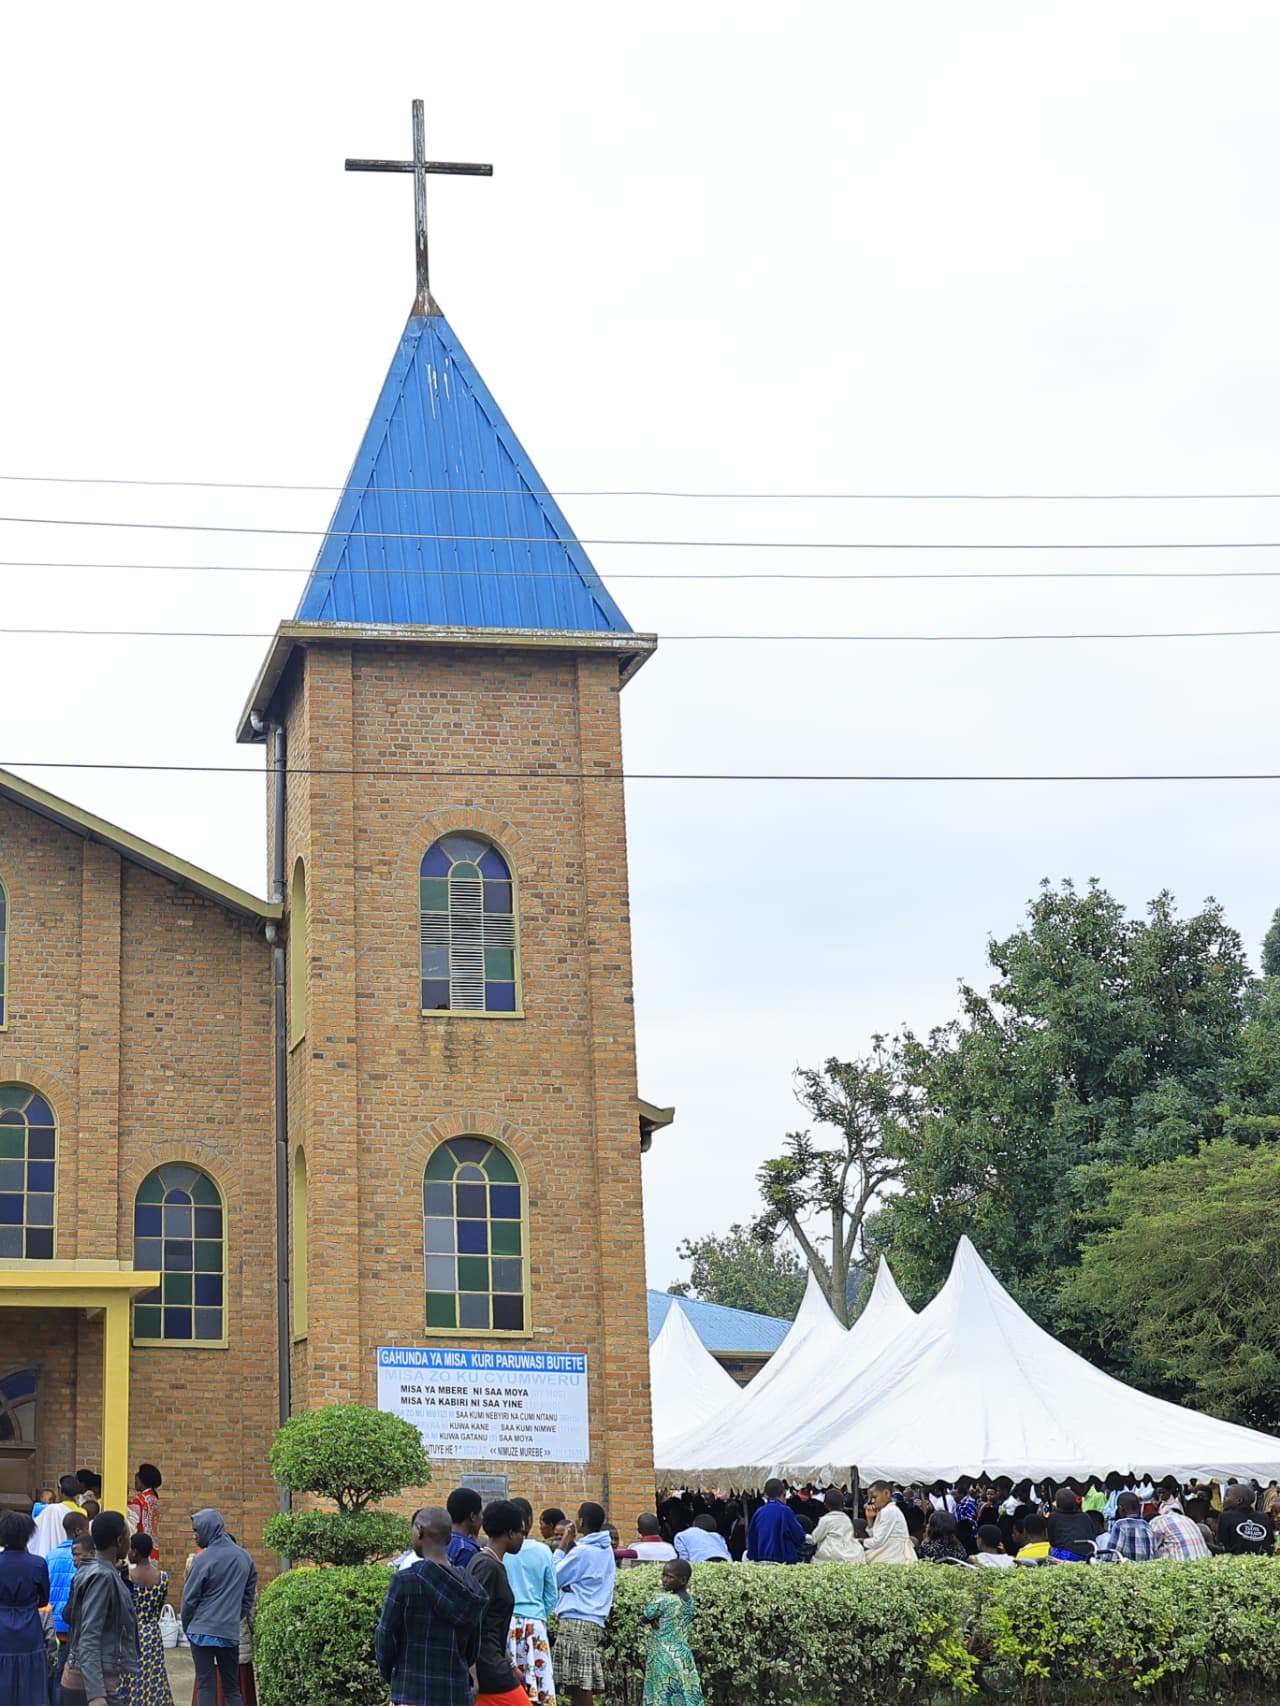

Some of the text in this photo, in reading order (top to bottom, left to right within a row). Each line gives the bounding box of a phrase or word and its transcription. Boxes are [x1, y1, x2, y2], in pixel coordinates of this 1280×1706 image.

[381, 1350, 583, 1371] GAHUNDA YA MISA KURI PARUWASI BUTETE
[384, 1369, 580, 1386] MISA ZO KU CYUMWERU
[400, 1385, 422, 1393] MISA
[425, 1385, 436, 1394] YA
[438, 1386, 469, 1395] MBERE
[473, 1387, 482, 1395] NI
[485, 1387, 502, 1396] SAA
[505, 1388, 528, 1397] MOYA
[400, 1397, 422, 1405] MISA
[425, 1397, 436, 1405] YA
[438, 1398, 468, 1407] KABIRI
[471, 1398, 480, 1407] NI
[482, 1399, 500, 1407] SAA
[502, 1400, 523, 1408] YINE
[456, 1411, 468, 1419] SAA
[469, 1411, 484, 1419] KUMI
[511, 1412, 519, 1420] NA
[460, 1433, 488, 1441] GATANU
[499, 1434, 513, 1442] SAA
[514, 1434, 533, 1442] MOYA
[519, 1448, 543, 1457] MUREBE
